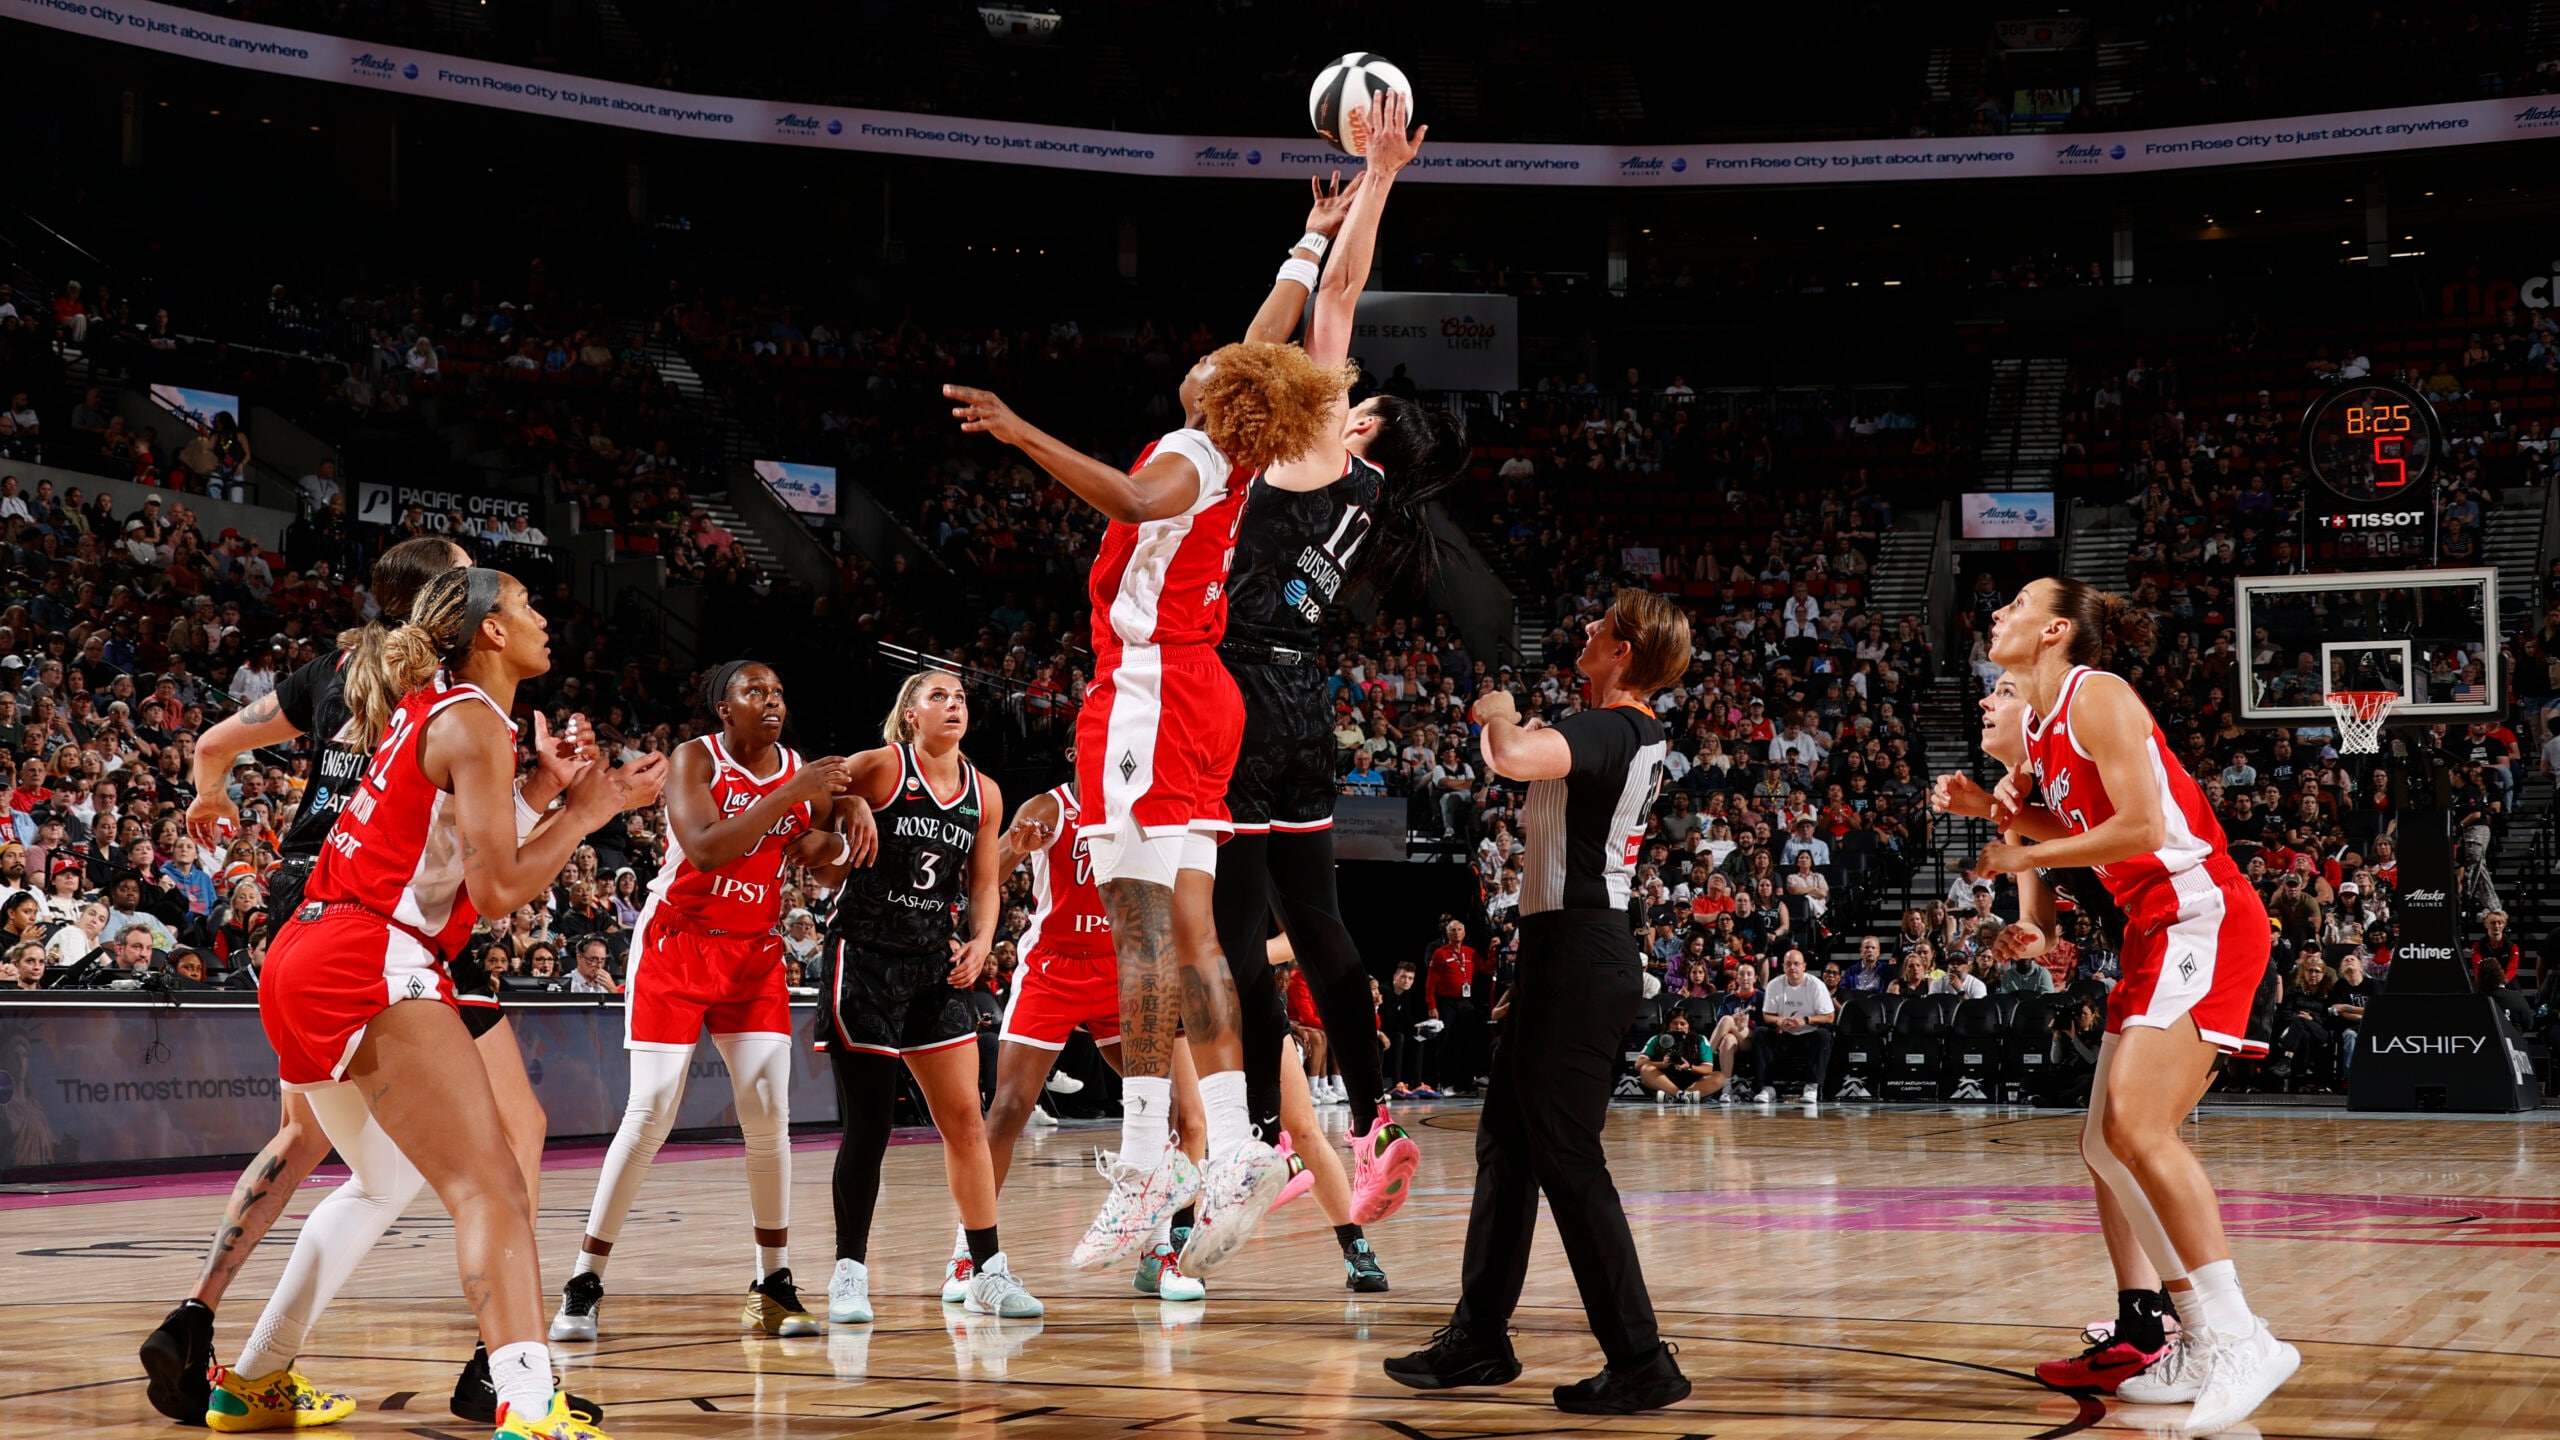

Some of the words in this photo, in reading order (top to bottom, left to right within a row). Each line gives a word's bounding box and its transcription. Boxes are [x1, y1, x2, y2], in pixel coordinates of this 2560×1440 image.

[90, 6, 124, 24] City
[128, 15, 145, 27] to
[147, 18, 177, 35] just
[180, 27, 225, 45] about
[229, 39, 308, 59] anywhere
[351, 54, 397, 71] Alaska
[439, 70, 480, 86] From
[483, 77, 522, 93] Rose
[525, 84, 557, 100] City
[561, 90, 578, 102] to
[580, 93, 608, 107] just
[612, 99, 655, 114] about
[658, 107, 733, 123] anywhere
[777, 115, 821, 130] Alaska
[862, 124, 903, 137] From
[906, 128, 945, 141] Rose
[948, 132, 980, 146] City
[984, 136, 1000, 145] to
[1003, 136, 1031, 148] just
[1035, 140, 1079, 152] about
[1082, 145, 1154, 158] anywhere
[2146, 143, 2188, 154] From
[2192, 140, 2233, 150] Rose
[2236, 136, 2271, 147] City
[2275, 134, 2294, 143] to
[2296, 130, 2328, 144] just
[2332, 126, 2382, 138] about
[2386, 119, 2468, 134] anywhere
[1197, 148, 1240, 161] Alaska
[1281, 153, 1322, 163] From
[1325, 153, 1363, 165] Rose
[1423, 157, 1452, 168] just
[1456, 158, 1501, 167] about
[1505, 159, 1579, 170] anywhere
[1707, 159, 1748, 168] From
[1751, 158, 1791, 167] Rose
[1794, 157, 1828, 168] City
[1832, 157, 1849, 165] to
[1852, 155, 1882, 167] just
[1885, 154, 1935, 164] about
[1938, 152, 2014, 163] anywhere
[2057, 144, 2103, 159] Alaska
[1621, 157, 1664, 170] Alaska
[1354, 325, 1377, 337] ER
[1383, 326, 1426, 338] SEATS
[1441, 318, 1495, 338] Coors
[1448, 339, 1490, 350] LIGHT
[2347, 405, 2411, 434] 8:25
[2374, 436, 2406, 487] 5
[399, 486, 463, 511] PACIFIC
[468, 496, 529, 519] OFFICE
[1979, 508, 2019, 519] Alaska
[2347, 511, 2425, 528] TISSOT
[1322, 503, 1372, 571] 17
[1298, 594, 1322, 624] AT&
[321, 749, 363, 781] ENGSTL
[723, 786, 751, 813] Las
[959, 804, 979, 818] chime
[893, 816, 940, 840] ROSE
[942, 822, 975, 855] CITY
[913, 850, 942, 891] 3
[711, 874, 770, 904] IPSY
[2404, 888, 2446, 901] Alaska
[887, 889, 945, 912] LASHIFY
[1074, 914, 1111, 933] IPS
[2399, 943, 2450, 960] chime
[2372, 1036, 2487, 1054] LASHIFY
[56, 1079, 109, 1103] The
[114, 1076, 184, 1101] most
[188, 1075, 281, 1101] nonstop
